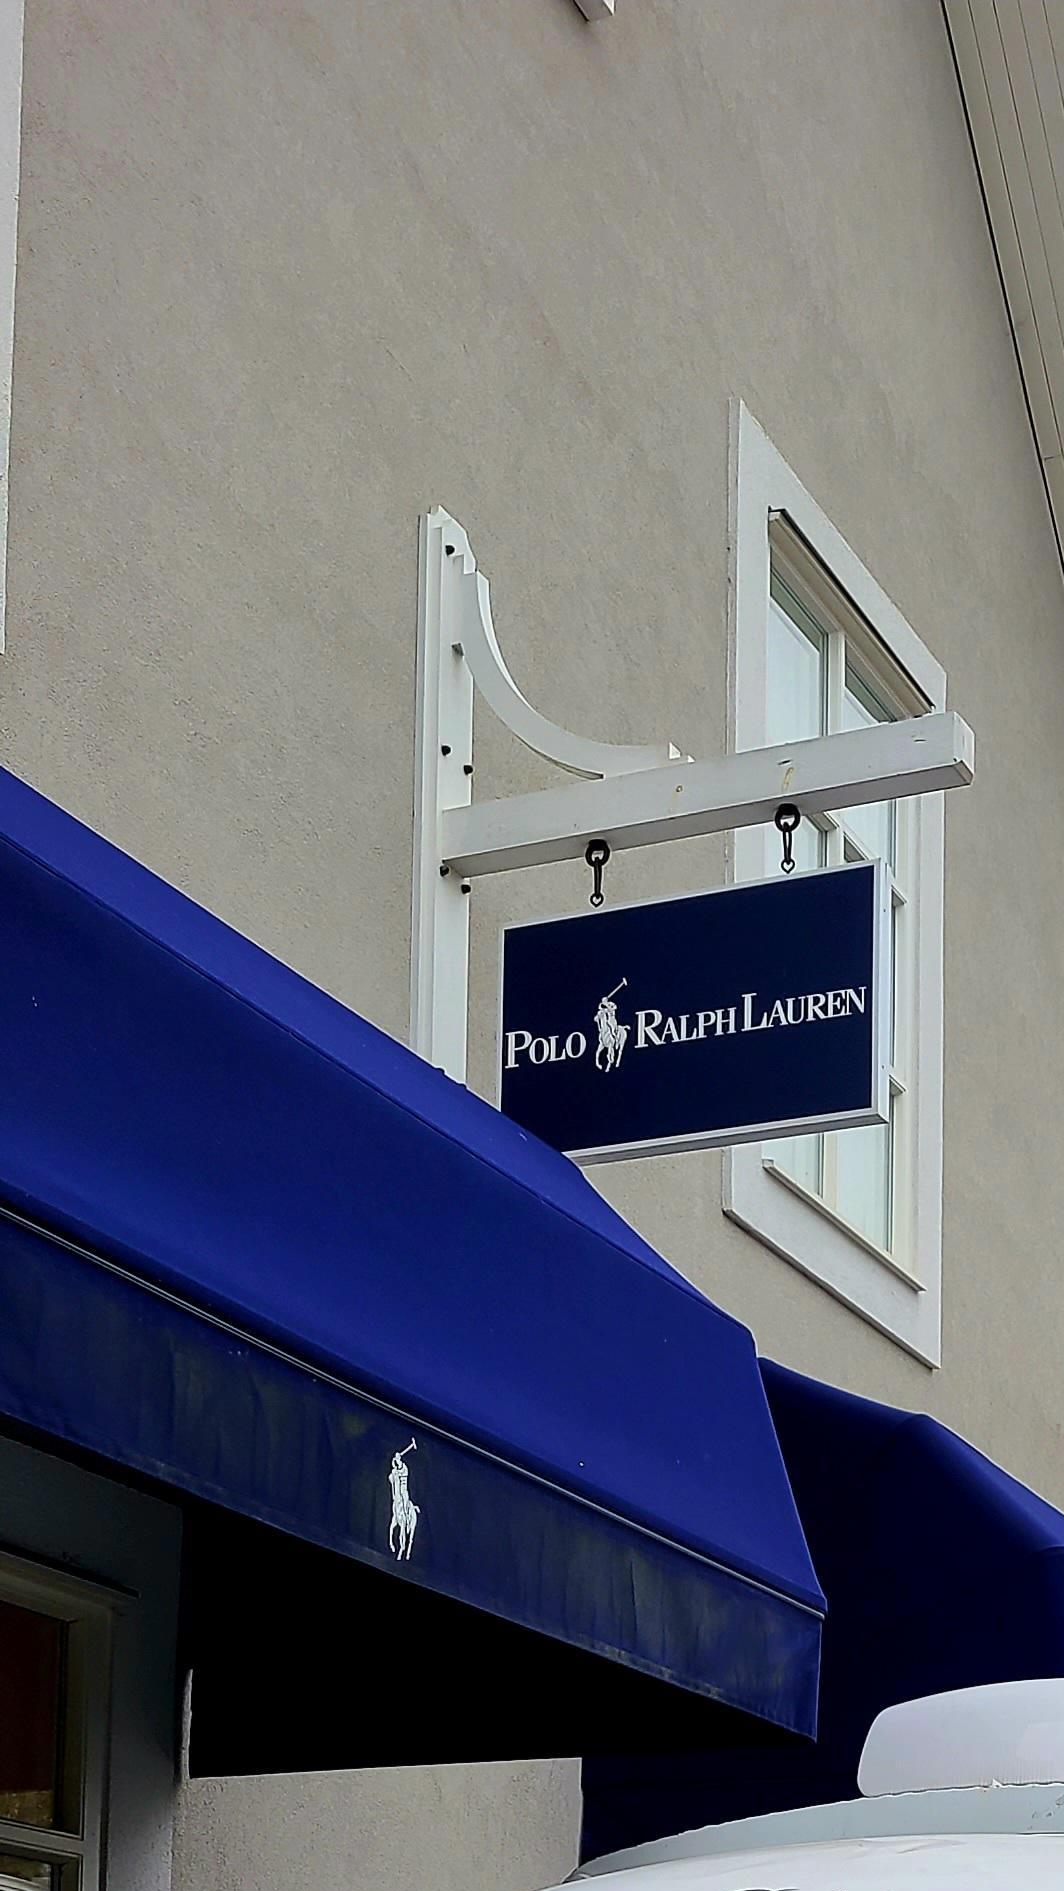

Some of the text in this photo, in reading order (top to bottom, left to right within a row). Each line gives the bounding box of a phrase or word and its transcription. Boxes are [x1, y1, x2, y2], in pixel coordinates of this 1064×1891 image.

[505, 986, 867, 1069] POLO RALPH LAUREN
